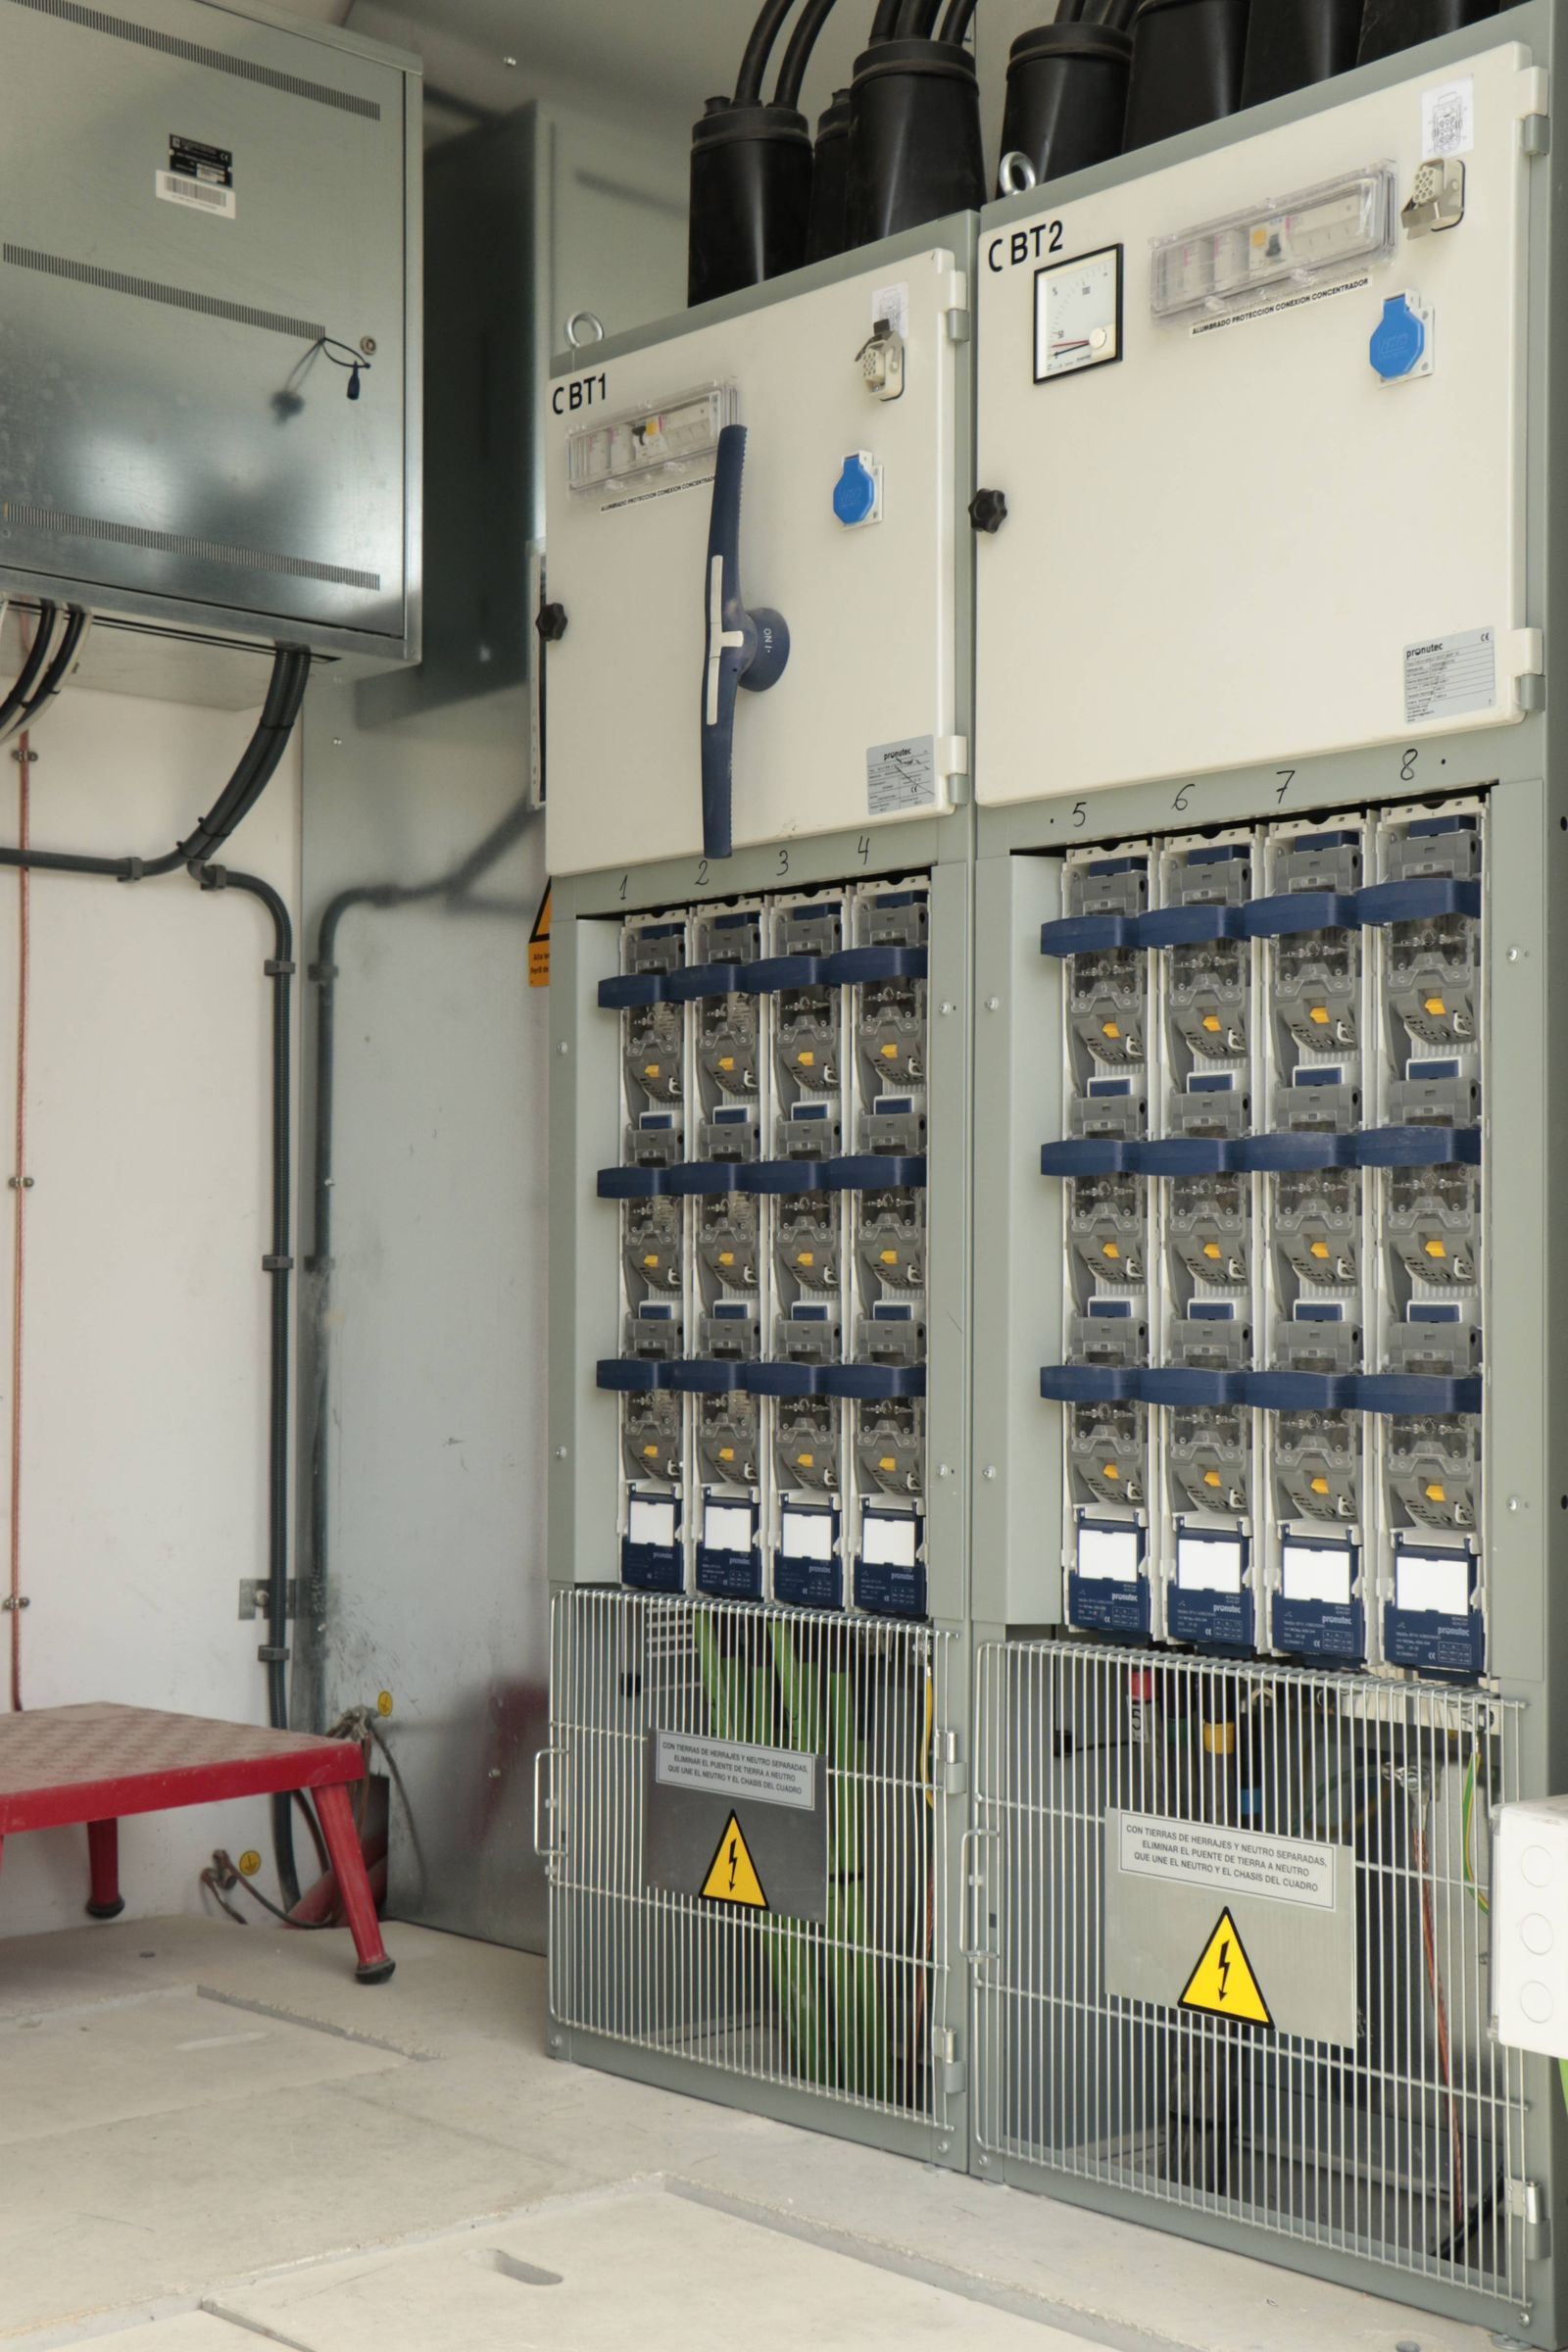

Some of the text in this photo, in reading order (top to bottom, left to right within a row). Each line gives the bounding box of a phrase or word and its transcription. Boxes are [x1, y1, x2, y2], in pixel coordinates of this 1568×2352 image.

[1193, 278, 1368, 334] ALUMBRADO PROTECCION CONEXION CONCENTRADOR
[1406, 643, 1444, 660] pronutec
[1400, 749, 1418, 781] 8
[1172, 784, 1196, 810] 6
[1276, 770, 1295, 804] 7
[1072, 802, 1087, 827] 5
[776, 850, 789, 876] 3
[858, 835, 870, 865] 4
[695, 860, 710, 885] 2
[619, 874, 628, 901] 1
[662, 1741, 675, 1750] CON
[676, 1744, 700, 1754] TIERRAS
[710, 1749, 740, 1761] HERRAJES
[746, 1756, 770, 1766] NEUTRO
[674, 1755, 701, 1765] ELIMINAR
[710, 1761, 732, 1771] PUENTE
[743, 1766, 764, 1777] TIERRA
[771, 1771, 796, 1782] NEUTRO
[681, 1767, 693, 1776] UNE
[702, 1771, 725, 1781] NEUTRO
[740, 1777, 762, 1788] CHASIS
[763, 1781, 774, 1789] DEL
[776, 1783, 802, 1794] CUADRO
[1127, 1825, 1143, 1834] CON
[1145, 1828, 1176, 1840] TIERRAS
[1178, 1833, 1189, 1842] DE
[1191, 1835, 1232, 1849] HERRAJES
[1241, 1844, 1274, 1857] NEUTRO
[1134, 1852, 1150, 1862] QUE
[1152, 1855, 1168, 1864] UNE
[1170, 1858, 1179, 1866] EL
[1181, 1860, 1213, 1872] NEUTRO
[1222, 1867, 1232, 1876] EL
[1234, 1869, 1263, 1882] CHASIS
[1265, 1875, 1280, 1885] DEL
[1283, 1878, 1318, 1891] CUADRO
[1142, 1840, 1178, 1853] ELIMINAR
[1180, 1846, 1189, 1855] EL
[1192, 1848, 1222, 1862] PUENTE
[1225, 1854, 1235, 1863] DE
[1238, 1857, 1266, 1869] TIERRA
[1276, 1863, 1309, 1877] NEUTRO
